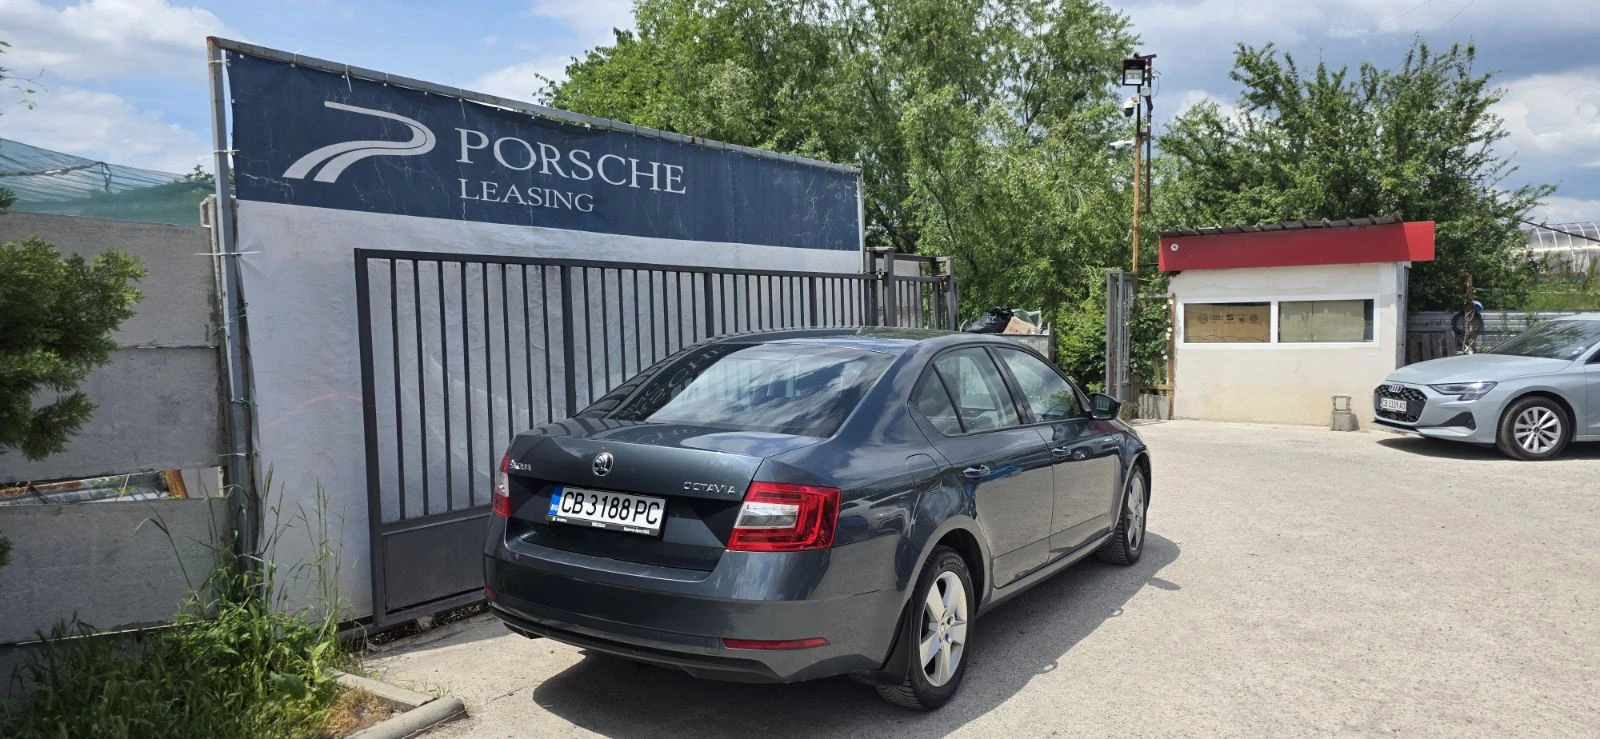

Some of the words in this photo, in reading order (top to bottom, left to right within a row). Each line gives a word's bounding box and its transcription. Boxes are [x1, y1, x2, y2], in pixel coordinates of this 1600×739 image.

[454, 127, 687, 195] PORSCHE
[458, 178, 595, 213] LEASING
[683, 481, 736, 494] OCTAVIA
[561, 491, 585, 514] CB
[586, 494, 631, 521] 3188
[632, 499, 660, 525] PC
